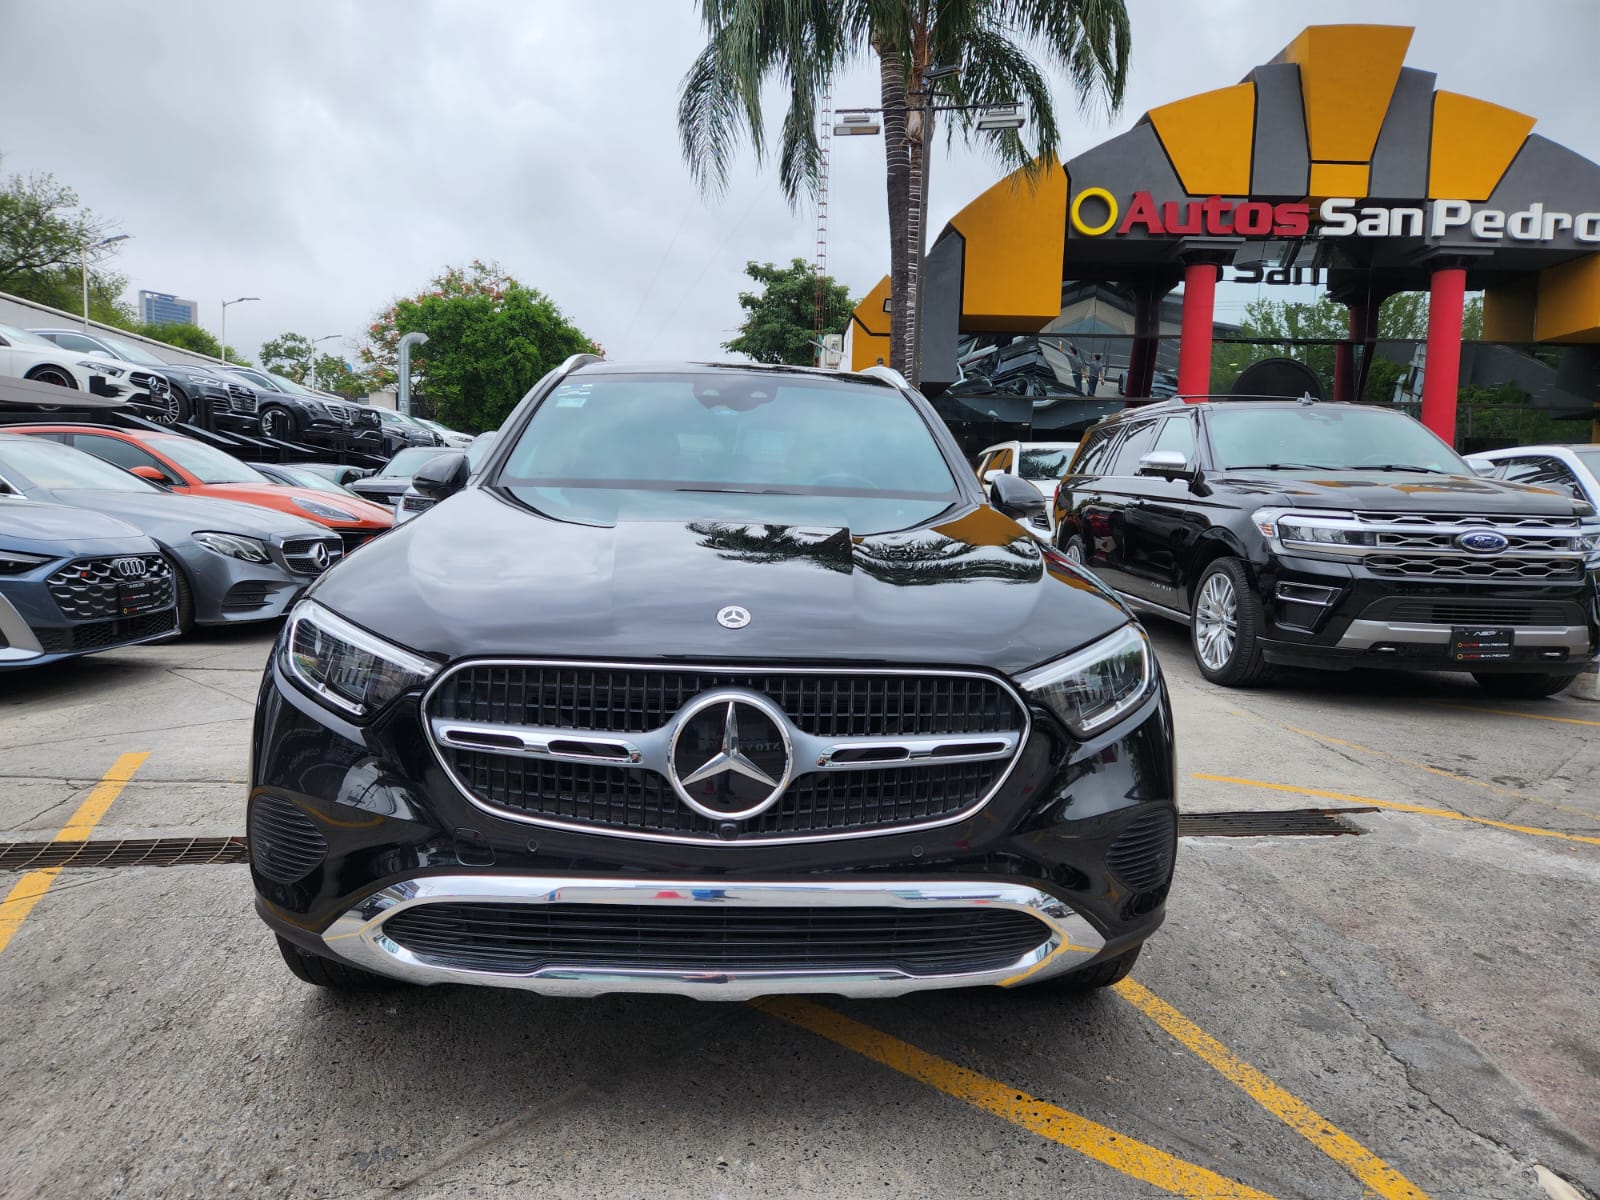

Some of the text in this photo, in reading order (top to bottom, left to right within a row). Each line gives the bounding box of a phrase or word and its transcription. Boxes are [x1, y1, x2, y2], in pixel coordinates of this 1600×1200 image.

[1116, 191, 1600, 242] Autos San Pedro
